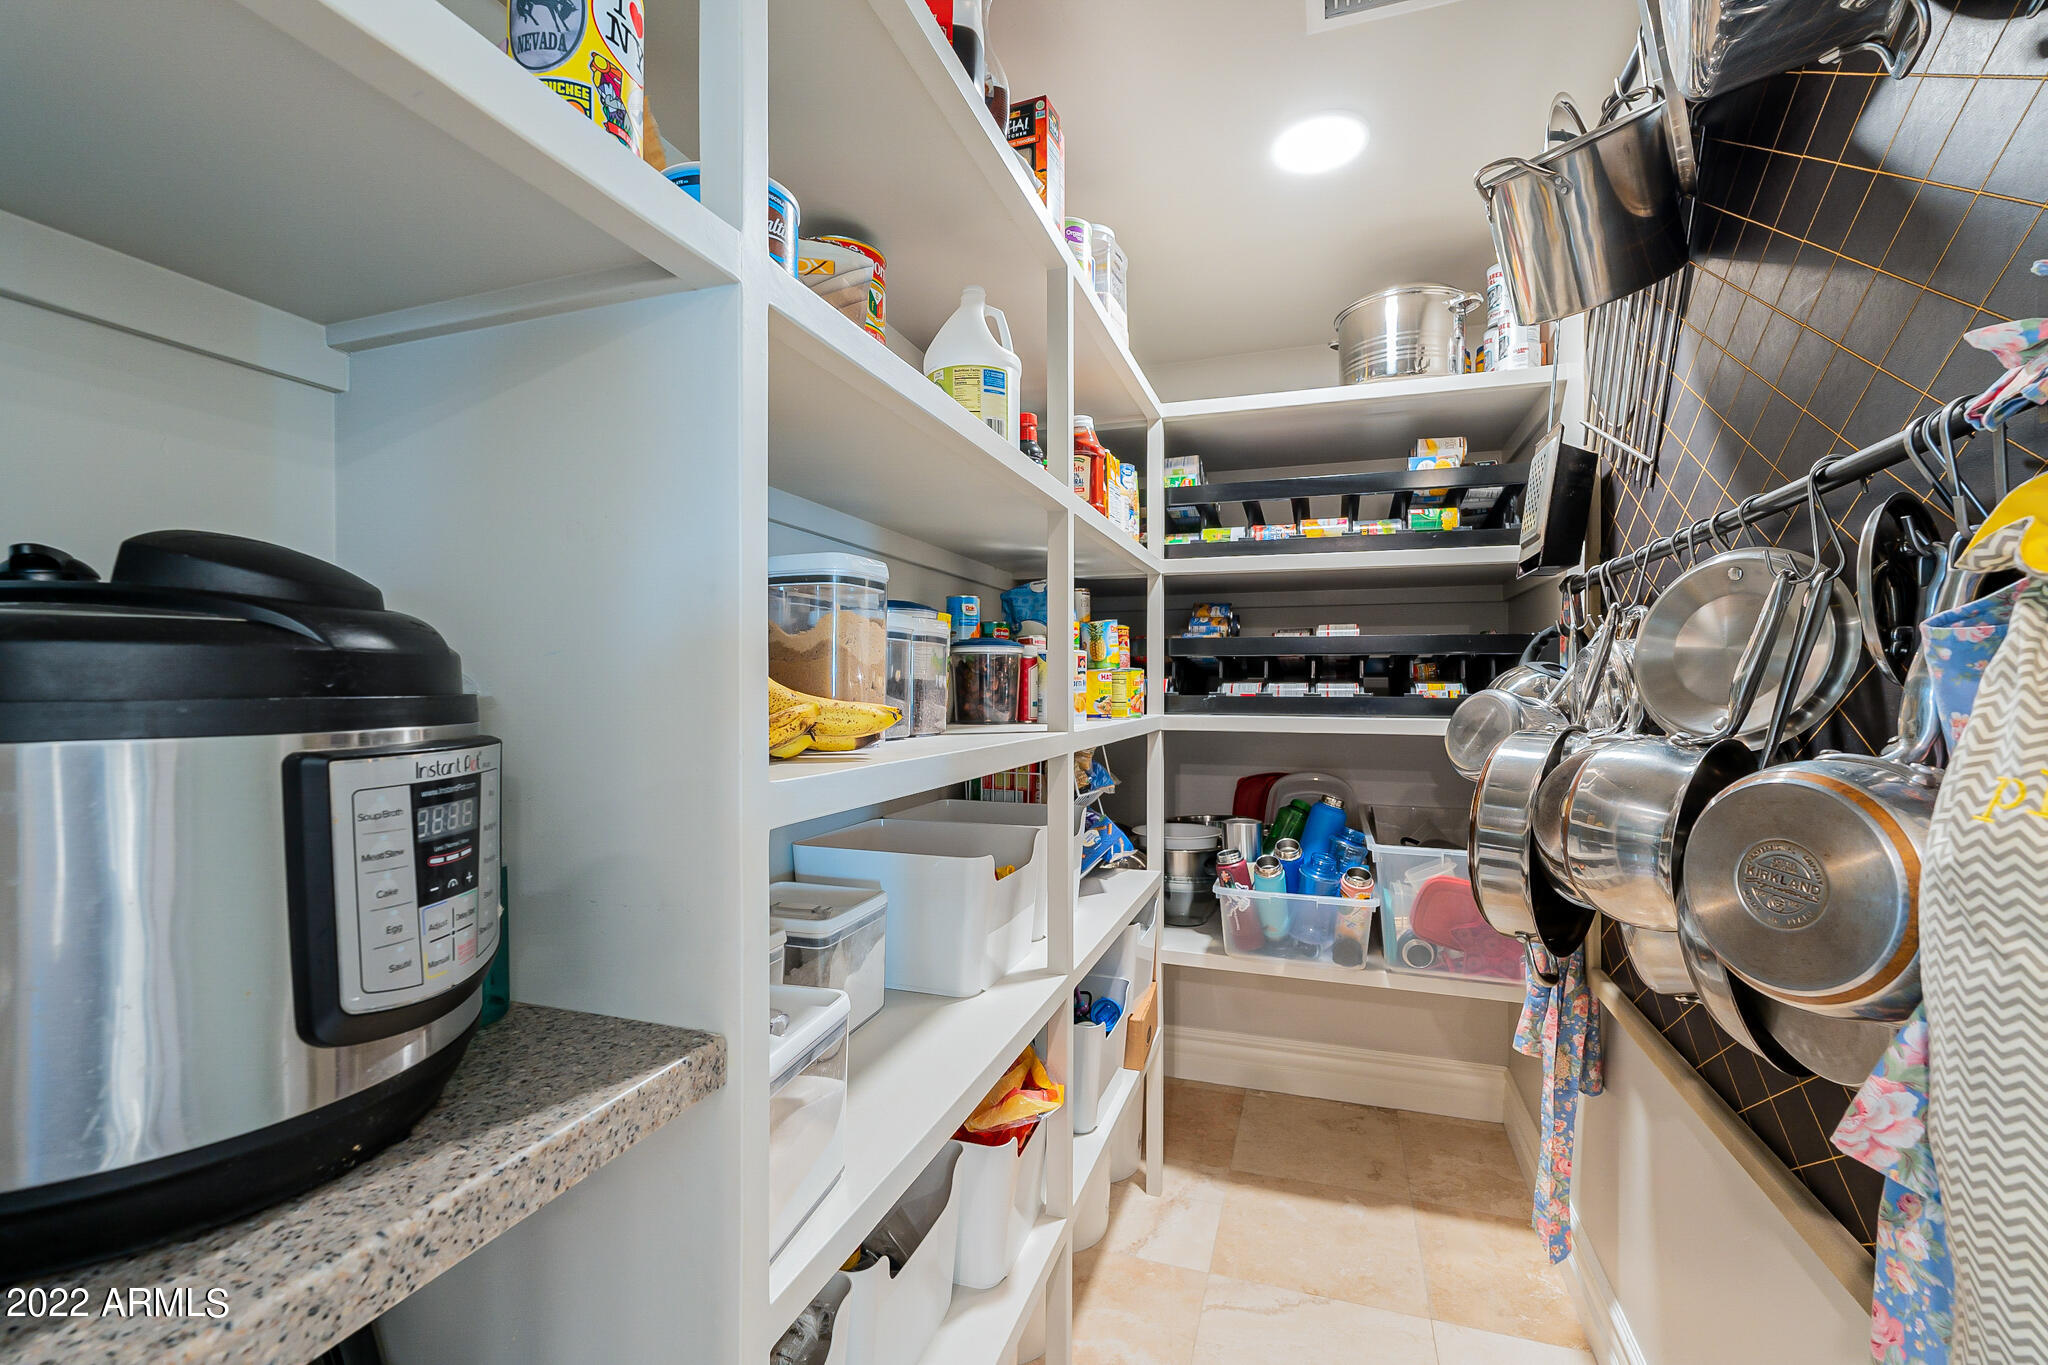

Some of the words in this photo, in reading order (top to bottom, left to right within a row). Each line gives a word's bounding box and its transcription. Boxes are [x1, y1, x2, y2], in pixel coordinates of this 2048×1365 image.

[517, 32, 567, 54] NEVADA
[543, 81, 590, 99] UCHEE
[415, 757, 462, 779] Instant
[464, 755, 481, 772] Pot
[1745, 865, 1821, 895] KIRKLAND
[376, 888, 399, 899] Cake
[385, 924, 403, 936] Egg
